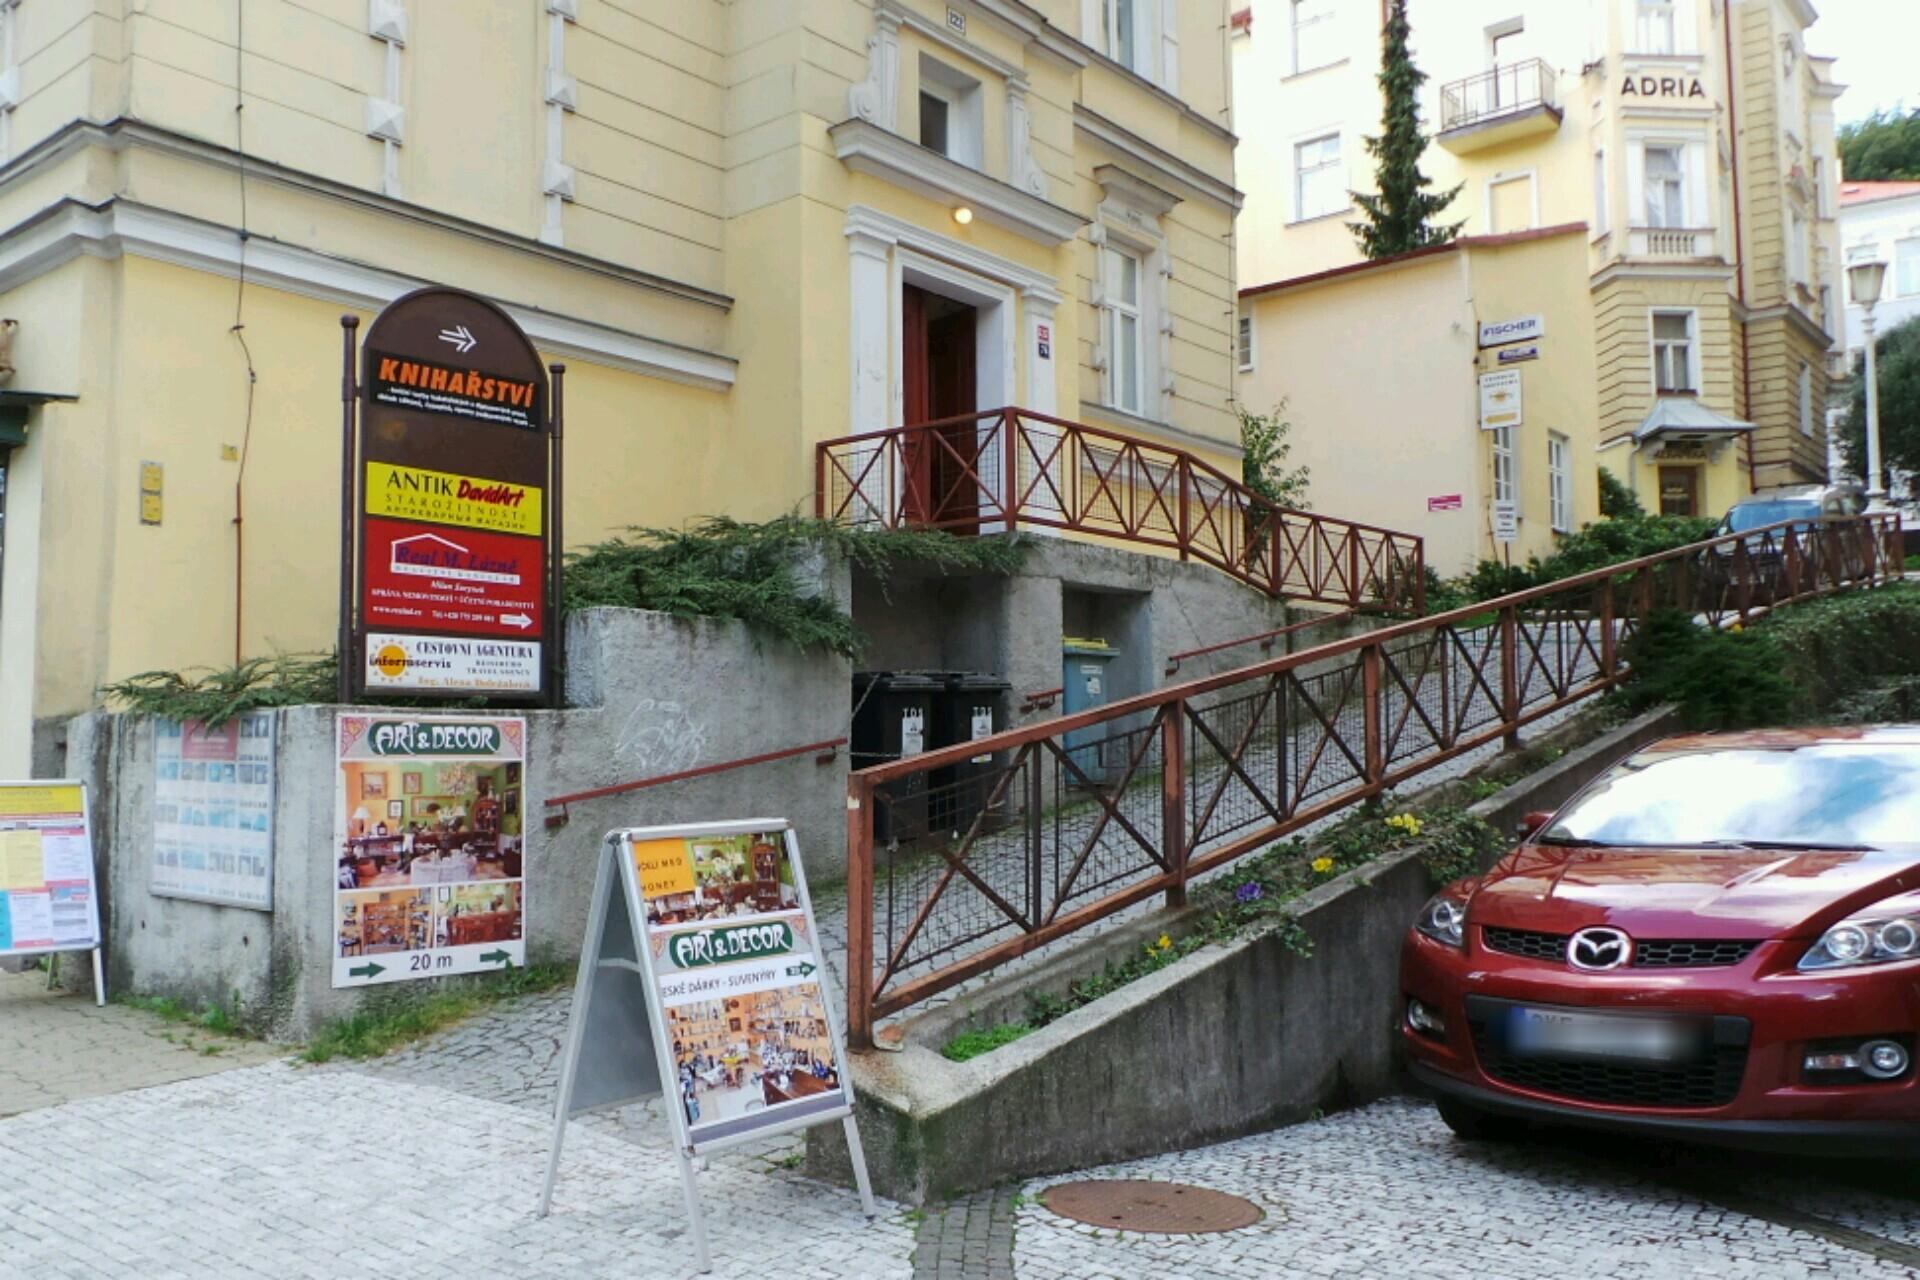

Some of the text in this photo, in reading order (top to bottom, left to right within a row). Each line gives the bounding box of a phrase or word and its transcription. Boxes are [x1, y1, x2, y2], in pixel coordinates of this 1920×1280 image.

[1621, 76, 1706, 98] ADRIA
[1483, 319, 1536, 336] FISCHER
[378, 357, 535, 407] KNIHAŘSTVÍ
[387, 470, 525, 508] ANTIK DavidArt
[416, 641, 533, 658] CESTOVNÍ AGENTURA
[410, 953, 453, 970] 20 m
[688, 977, 721, 994] DÁRKY
